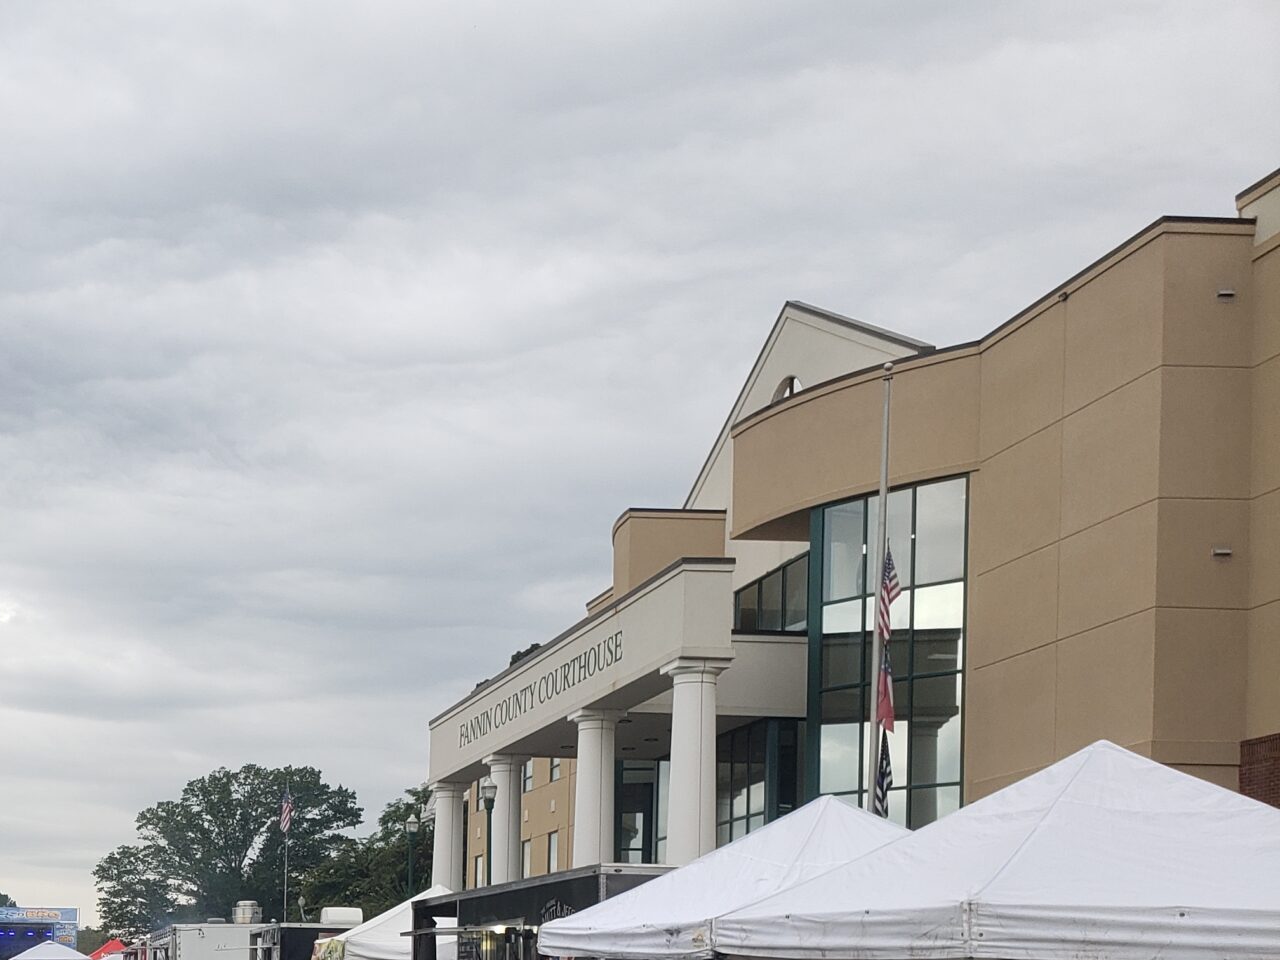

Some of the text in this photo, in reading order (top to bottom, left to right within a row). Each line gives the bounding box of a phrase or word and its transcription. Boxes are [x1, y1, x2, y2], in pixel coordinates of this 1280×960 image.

[458, 630, 623, 749] FANNIN COUNTY COURTHOUSE
